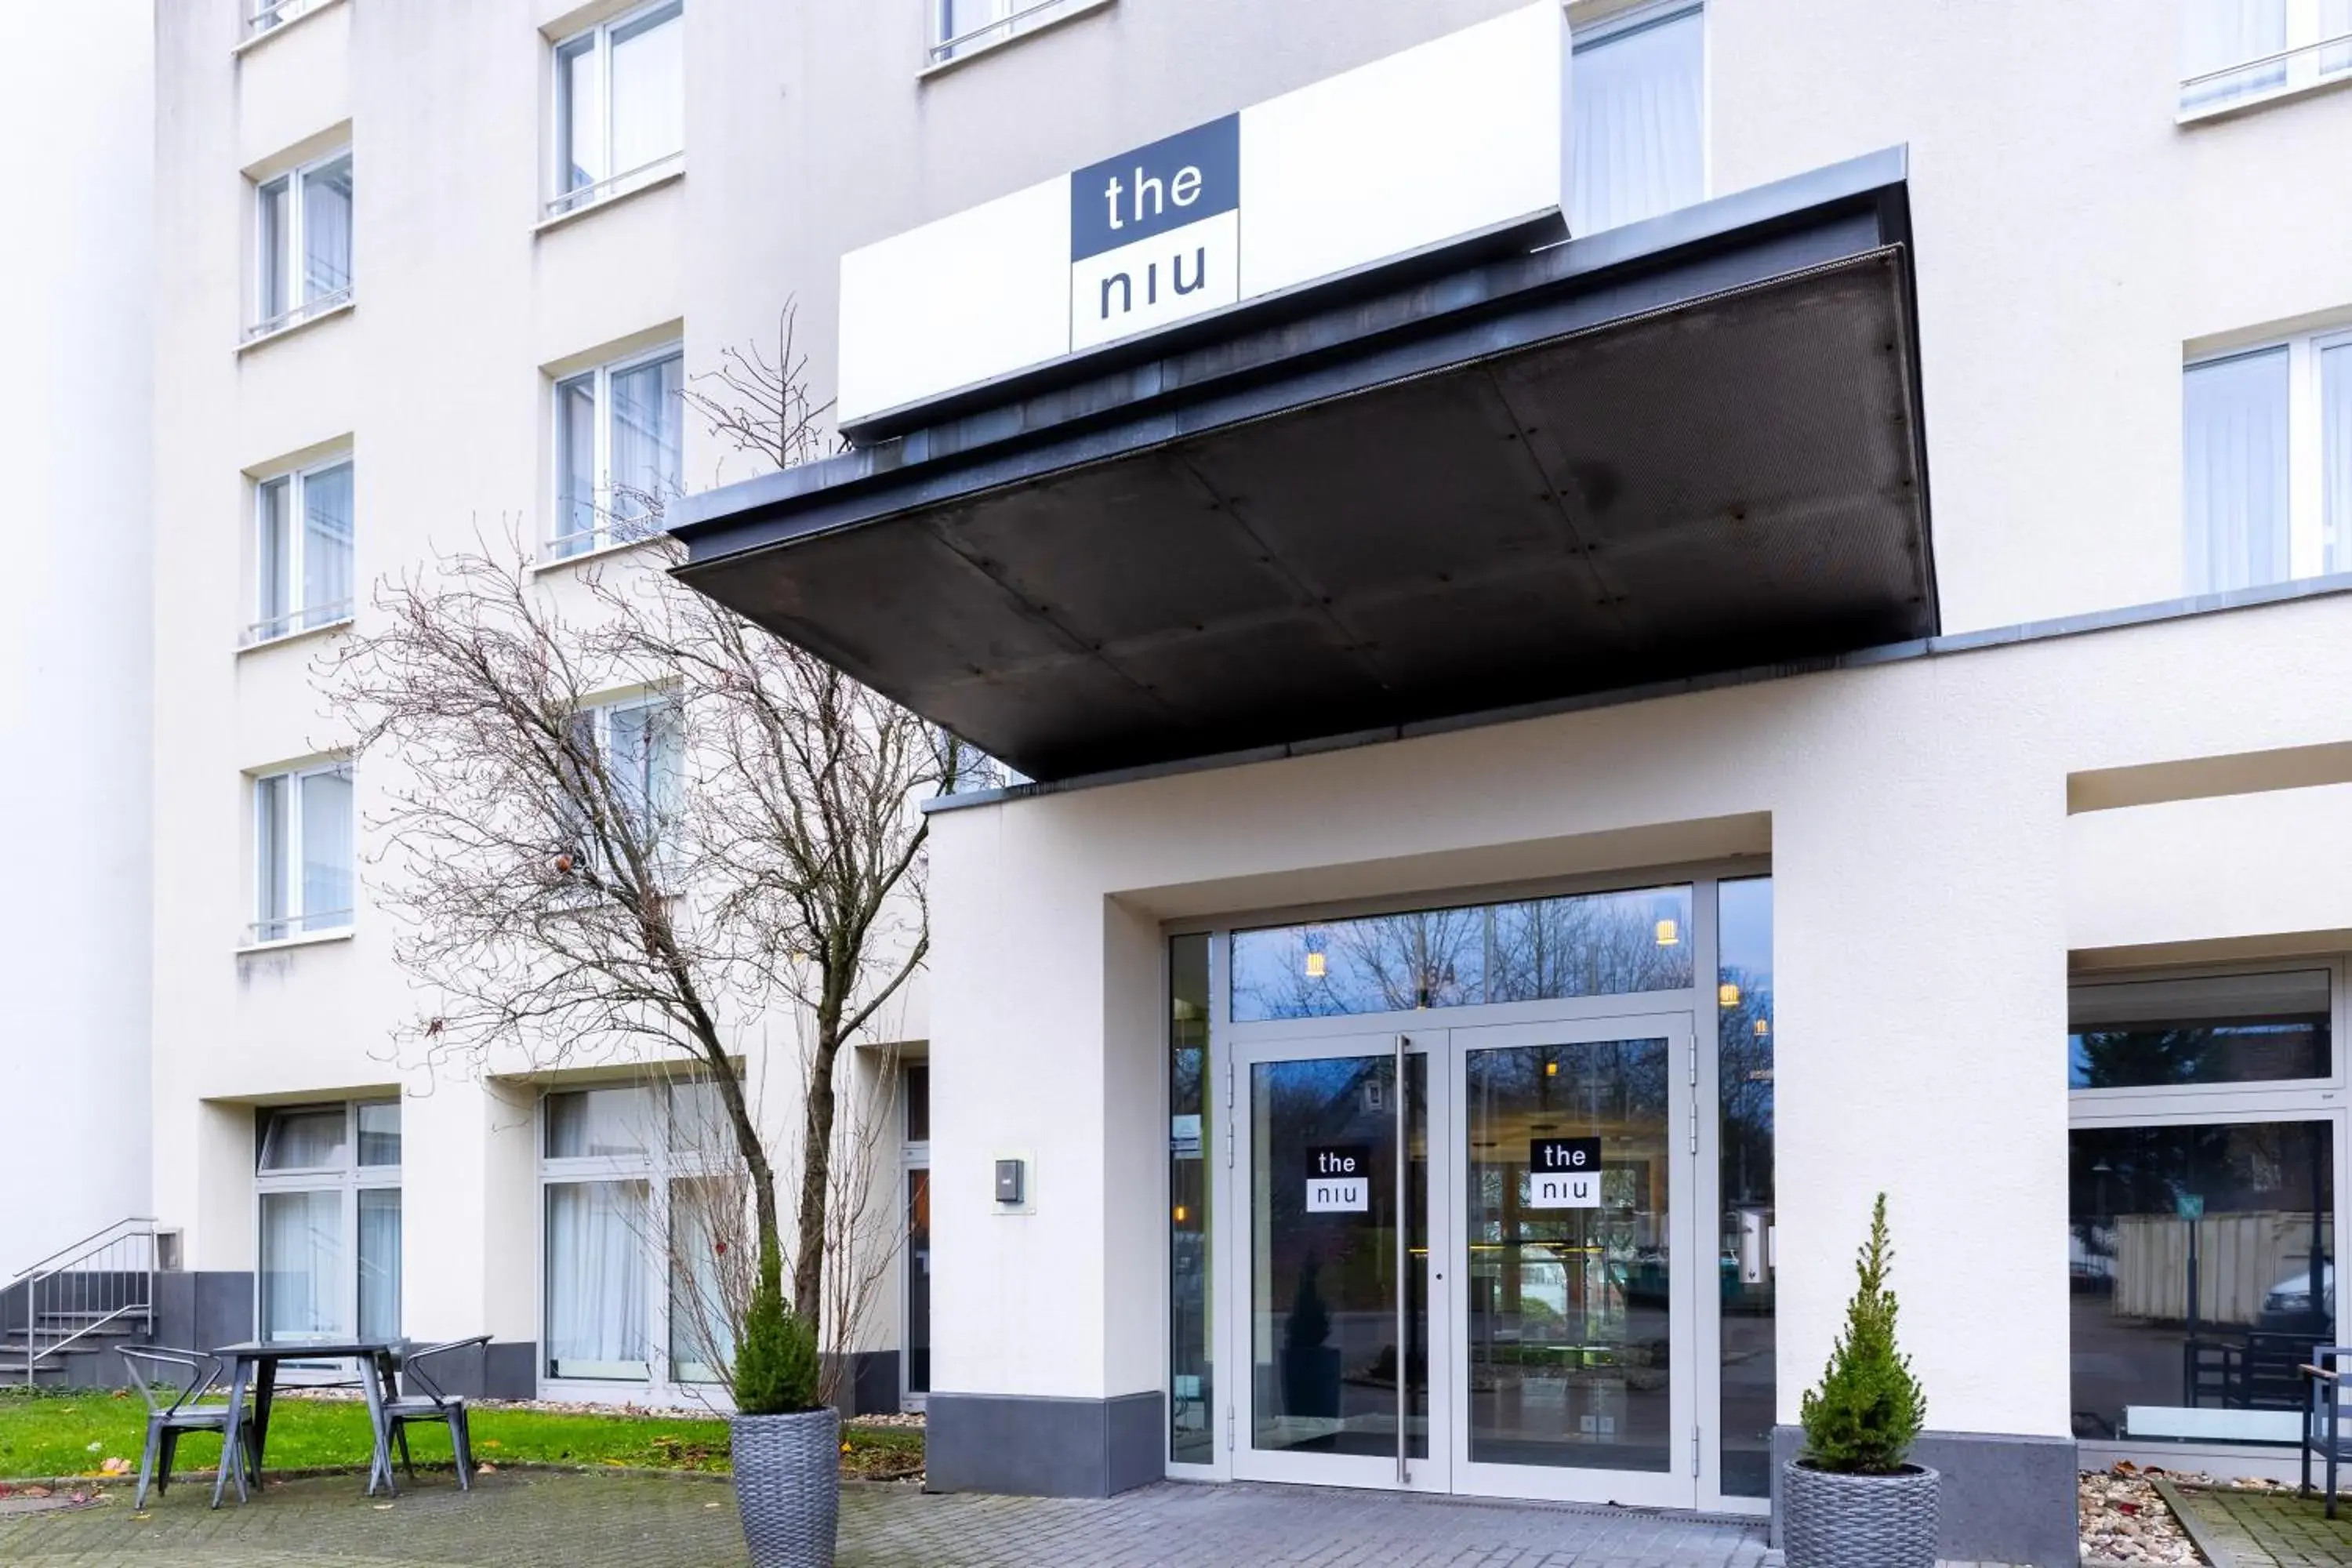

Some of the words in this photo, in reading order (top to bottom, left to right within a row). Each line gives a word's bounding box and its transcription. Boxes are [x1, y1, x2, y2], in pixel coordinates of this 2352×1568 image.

[1105, 165, 1202, 230] the
[1102, 247, 1205, 319] niu
[1318, 1152, 1356, 1174] the
[1543, 1144, 1586, 1167] the
[1317, 1186, 1356, 1203] niu
[1543, 1181, 1588, 1199] niu
